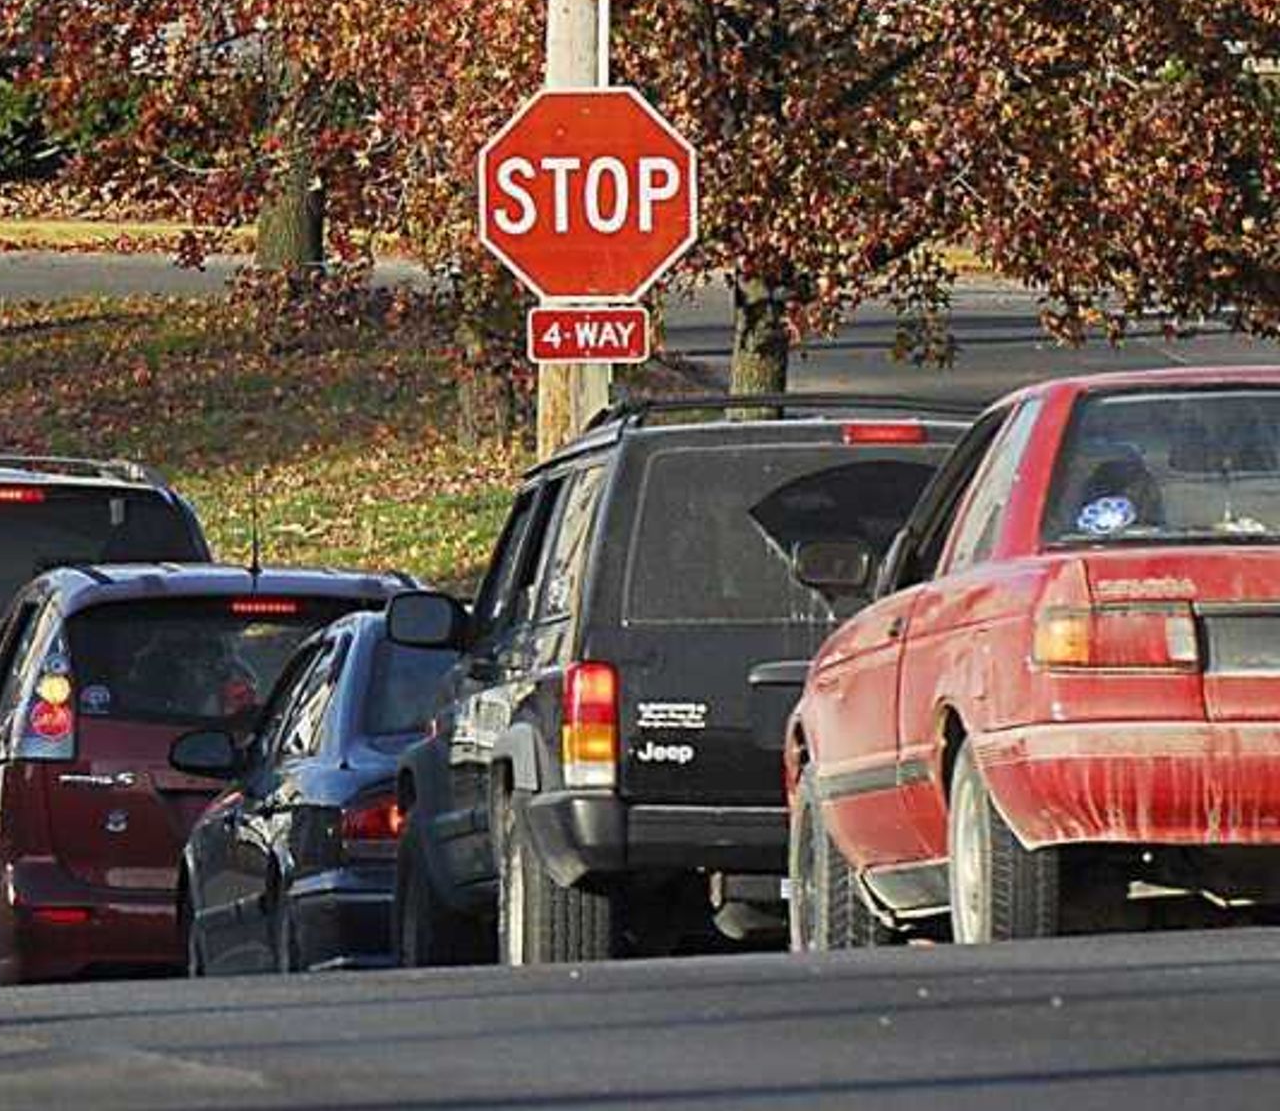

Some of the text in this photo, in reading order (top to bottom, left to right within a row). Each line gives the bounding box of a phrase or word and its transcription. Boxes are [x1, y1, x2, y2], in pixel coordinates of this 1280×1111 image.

[493, 155, 681, 235] STOP
[542, 320, 636, 350] 4-WAY
[637, 741, 694, 764] Jeep
